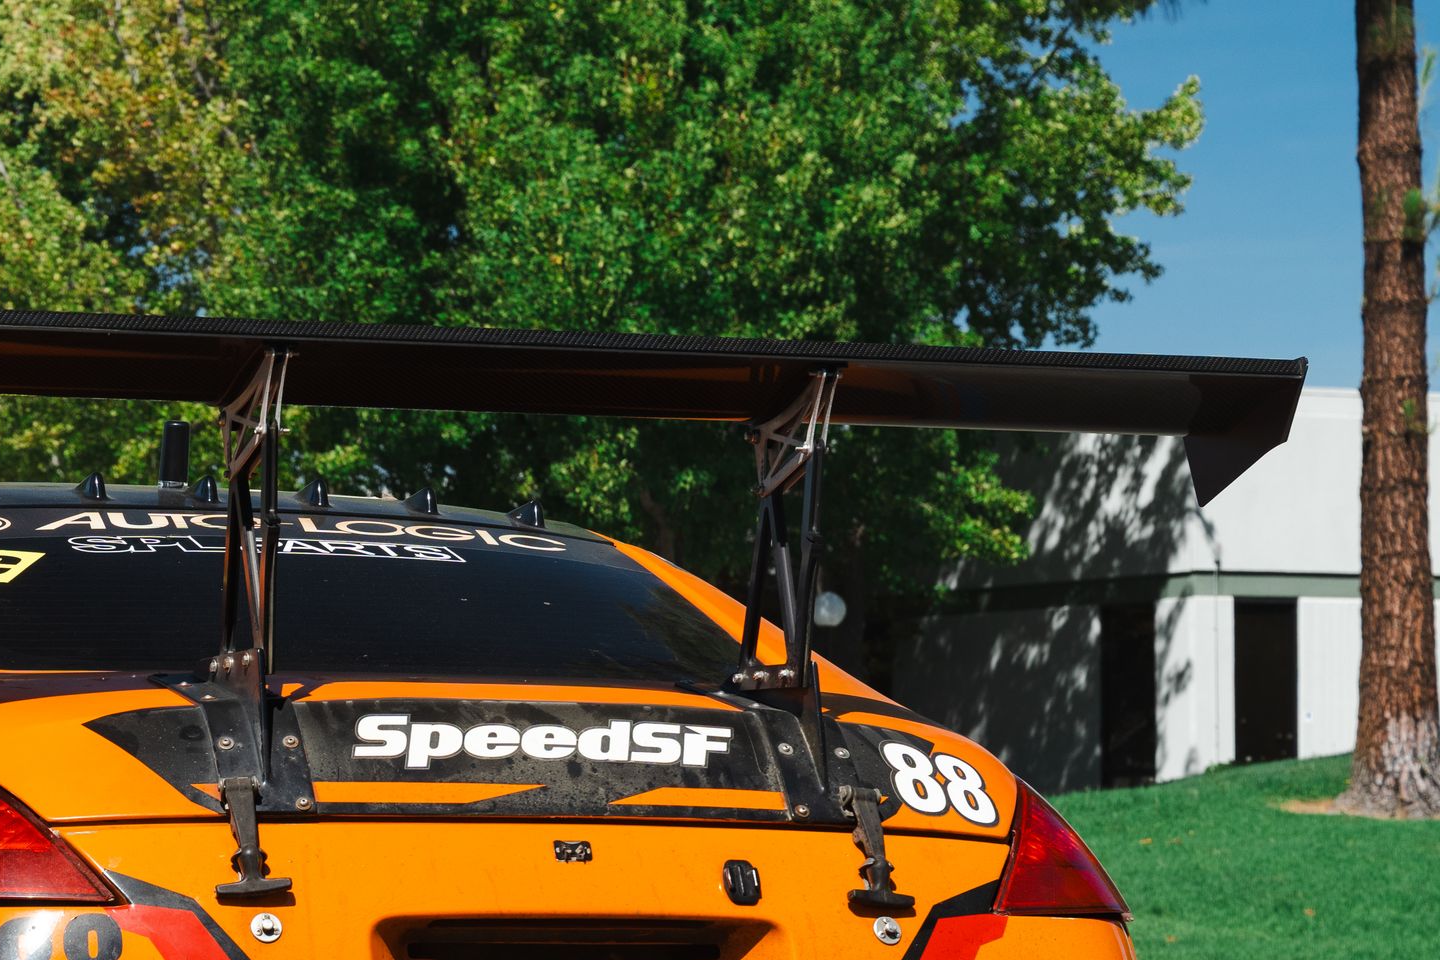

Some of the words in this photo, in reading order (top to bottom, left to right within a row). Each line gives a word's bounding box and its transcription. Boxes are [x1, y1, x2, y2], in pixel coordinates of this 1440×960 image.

[35, 511, 567, 551] AUTO-LOGIC
[352, 713, 734, 769] SpeedSF
[881, 741, 999, 827] 88
